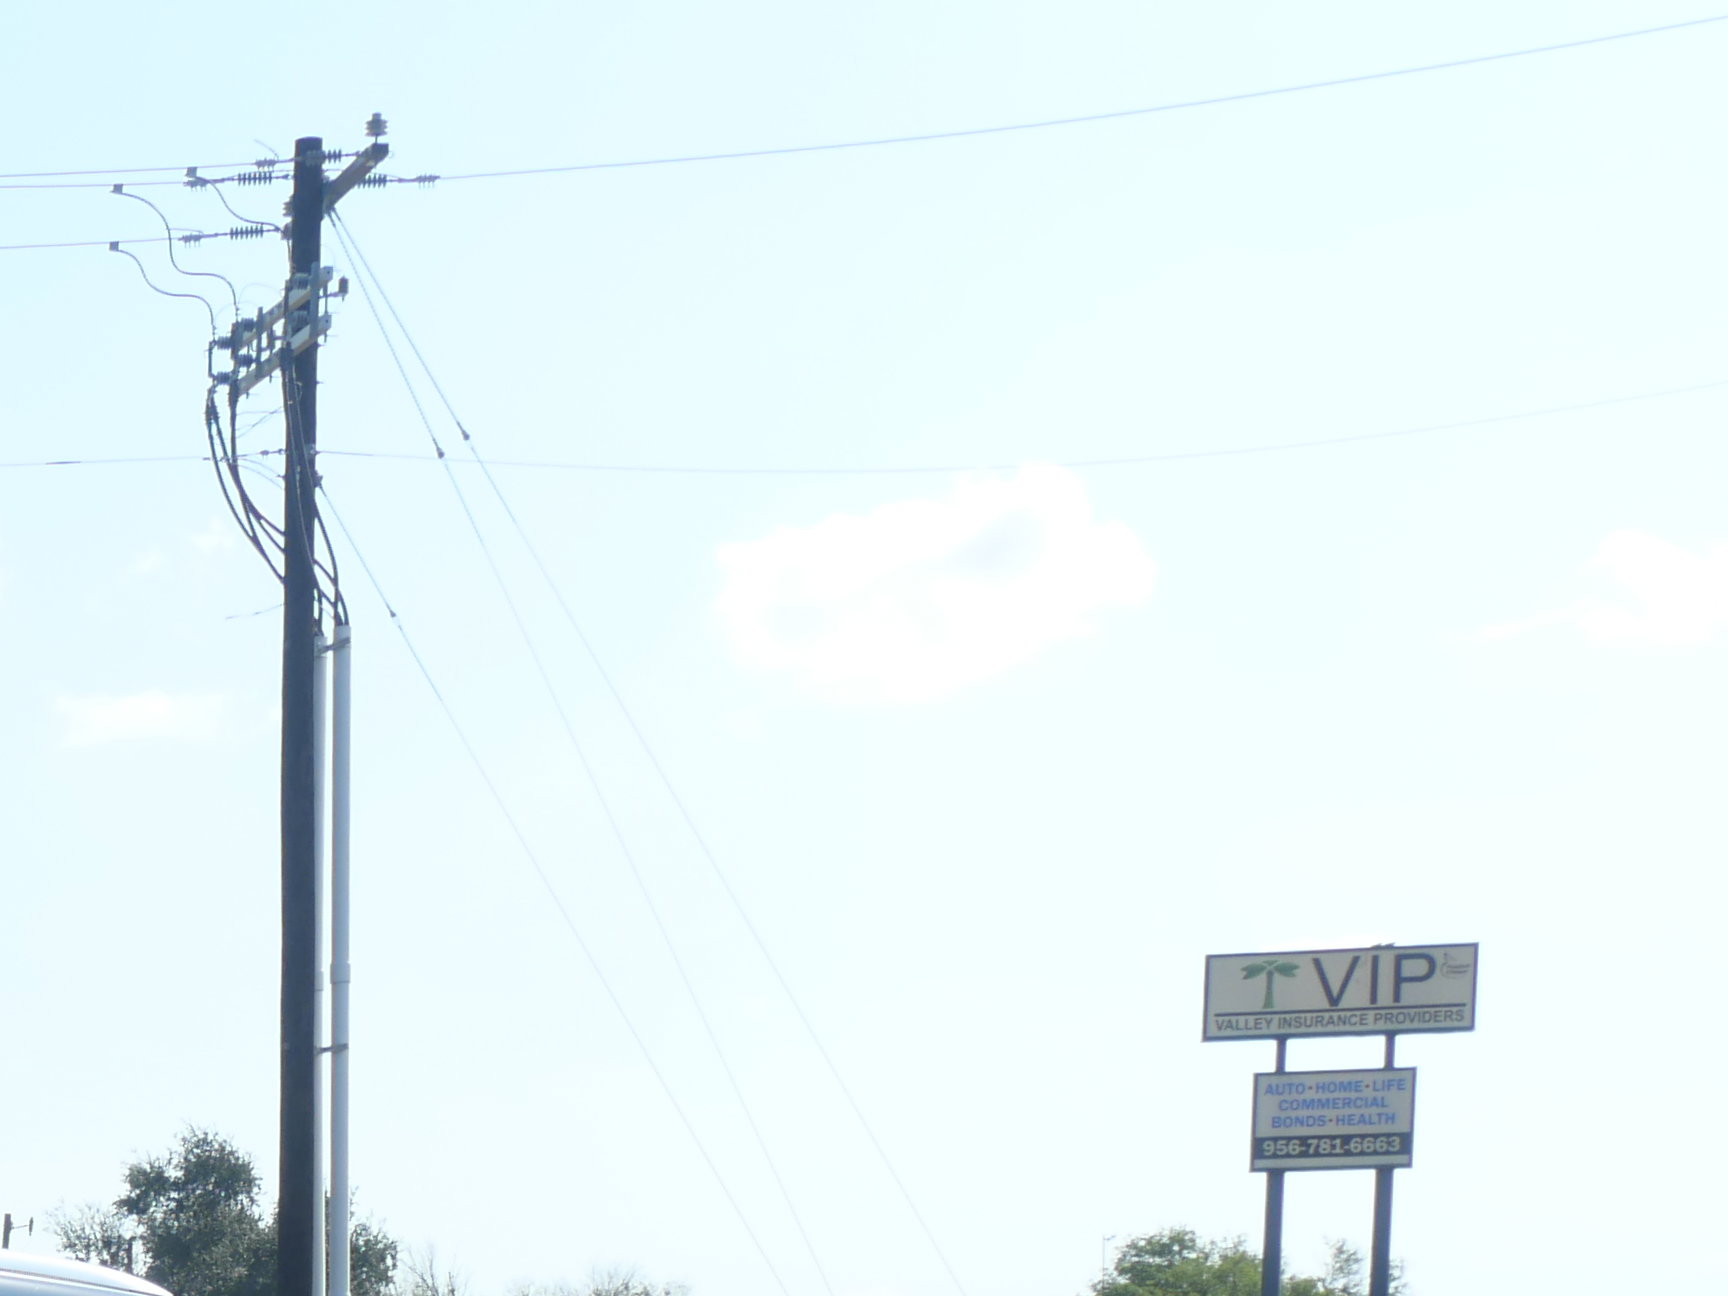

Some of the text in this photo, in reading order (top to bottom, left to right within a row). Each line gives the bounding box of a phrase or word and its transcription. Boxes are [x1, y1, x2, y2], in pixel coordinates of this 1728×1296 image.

[1312, 952, 1436, 1007] VIP
[1215, 1009, 1464, 1031] VALLEY INSURANCE PROVIDERS
[1264, 1078, 1406, 1096] AUTO HOME LIFE
[1278, 1096, 1388, 1111] COMMERCIAL
[1271, 1112, 1396, 1128] BONDS HEALTH
[1263, 1136, 1400, 1155] 956-781-6663
